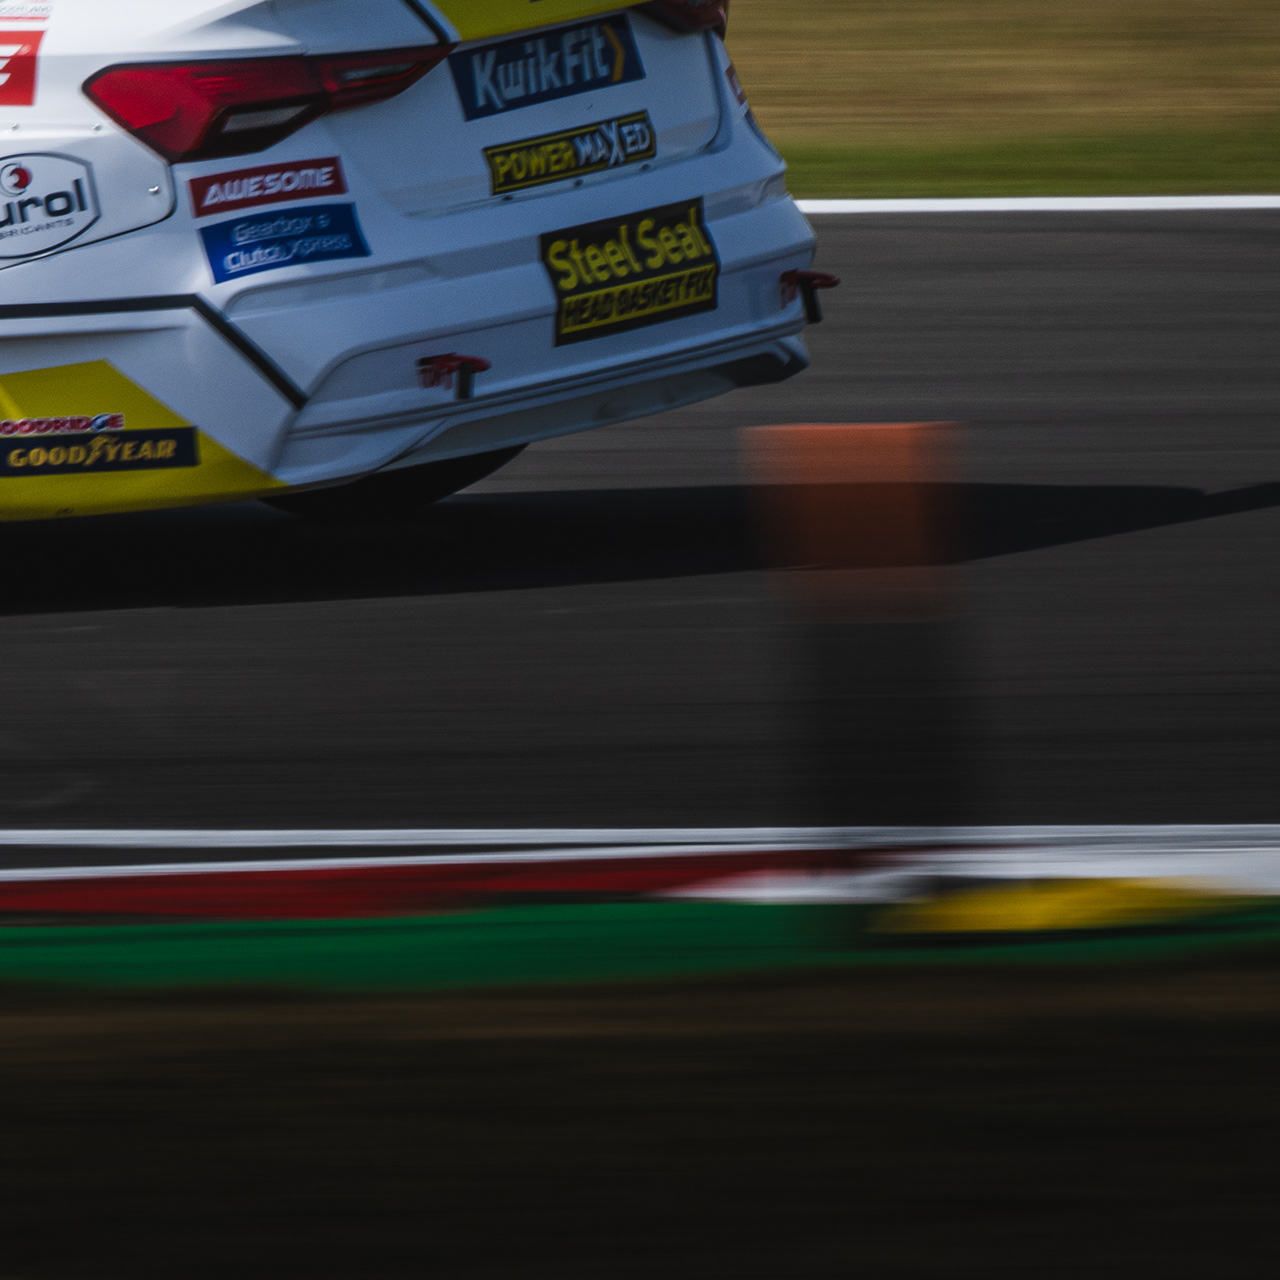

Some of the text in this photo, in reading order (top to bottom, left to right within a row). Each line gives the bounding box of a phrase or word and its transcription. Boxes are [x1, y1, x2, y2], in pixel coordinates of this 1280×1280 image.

[202, 165, 335, 206] AWESOME
[547, 206, 712, 291] Steel Seal
[8, 434, 178, 467] GOODYEAR
